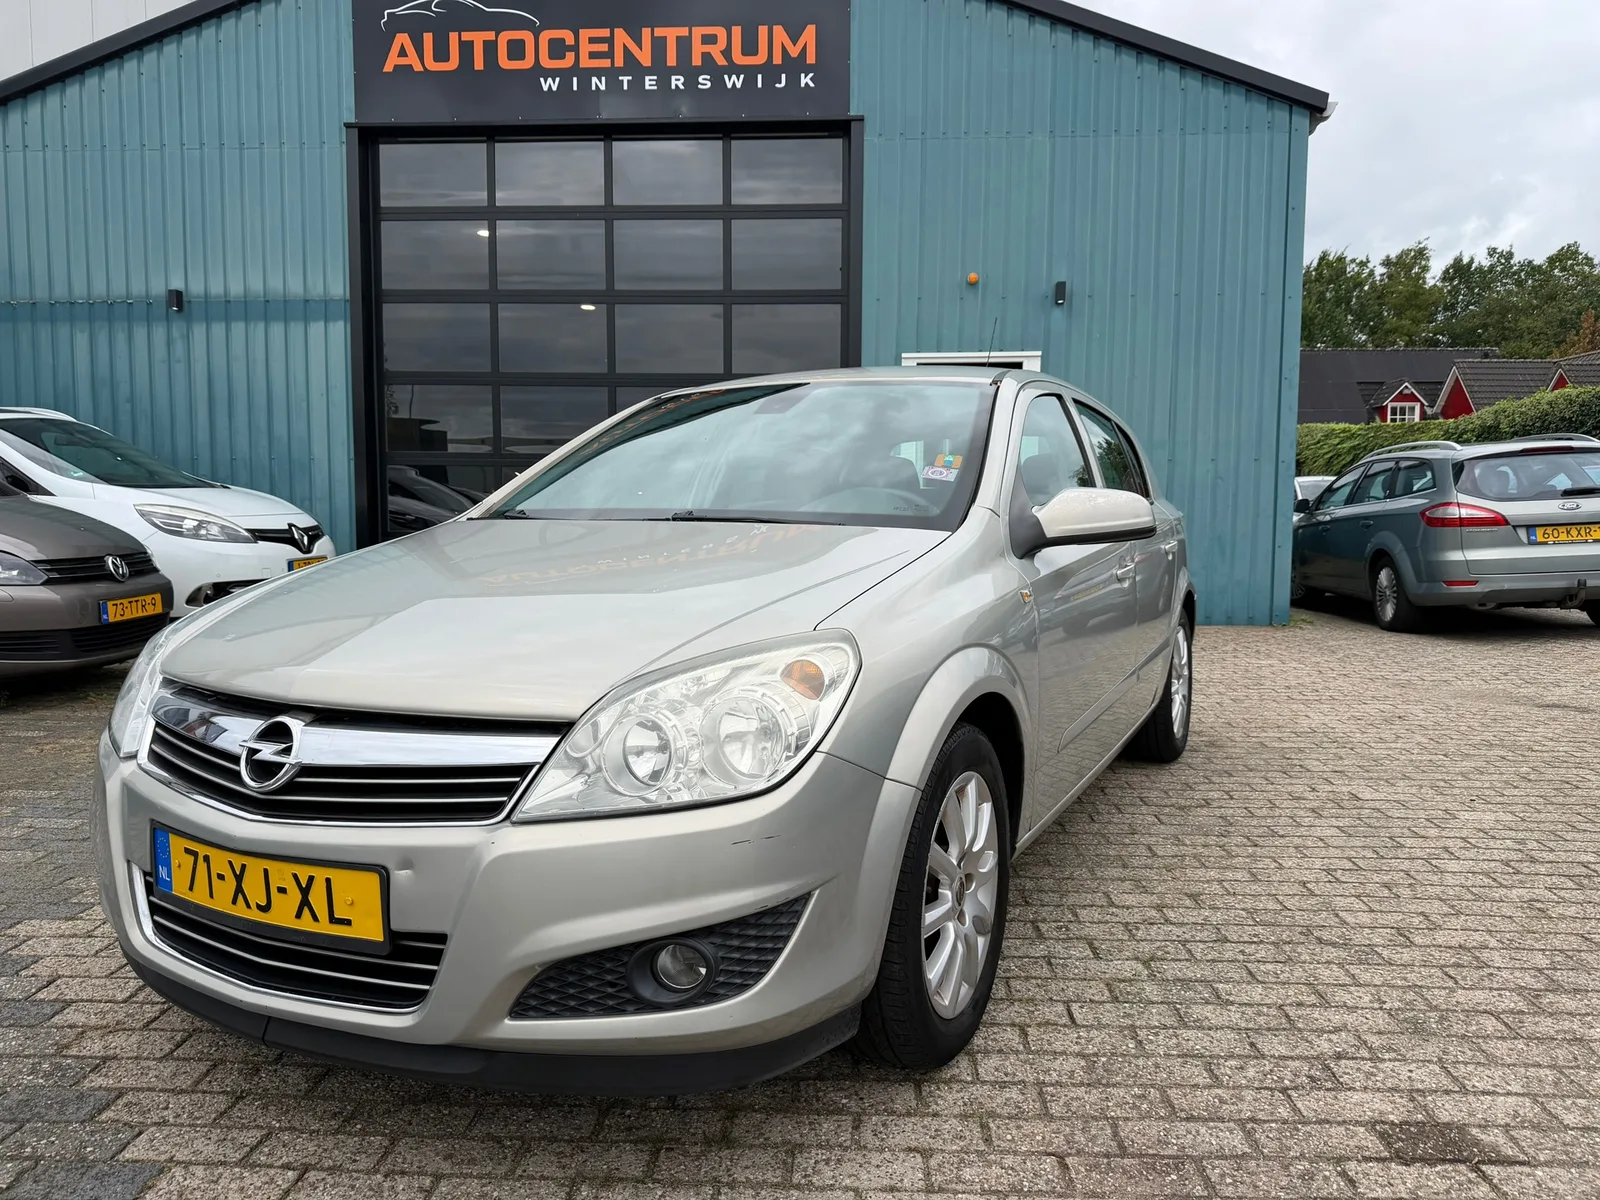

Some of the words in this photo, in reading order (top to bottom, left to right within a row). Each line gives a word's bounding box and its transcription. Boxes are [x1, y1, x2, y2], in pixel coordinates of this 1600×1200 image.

[382, 24, 816, 73] AUTOCENTRUM
[540, 72, 816, 92] WINTERSWIJK
[112, 597, 157, 619] 73-TTR-9
[158, 864, 171, 882] NL
[183, 846, 353, 927] 71-XJ-XL
